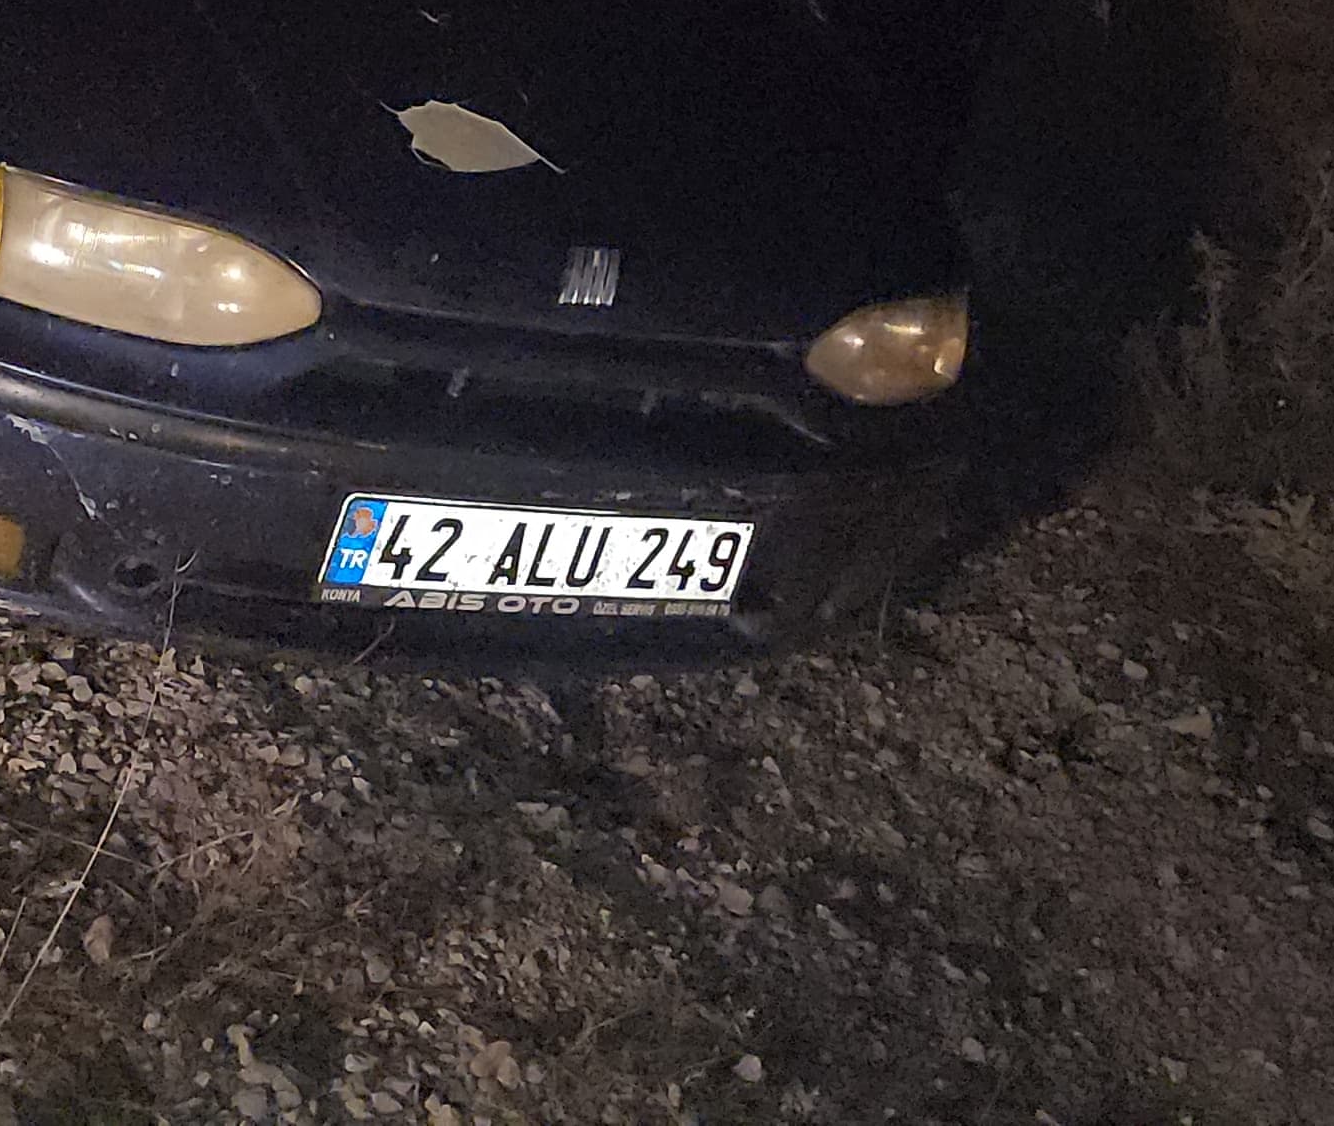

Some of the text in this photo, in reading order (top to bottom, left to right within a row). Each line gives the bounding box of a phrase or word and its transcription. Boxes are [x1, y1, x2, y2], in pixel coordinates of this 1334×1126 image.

[339, 548, 368, 569] TR
[378, 514, 741, 591] 42 ALU 249
[321, 589, 361, 602] KONYA
[497, 595, 580, 615] OTO
